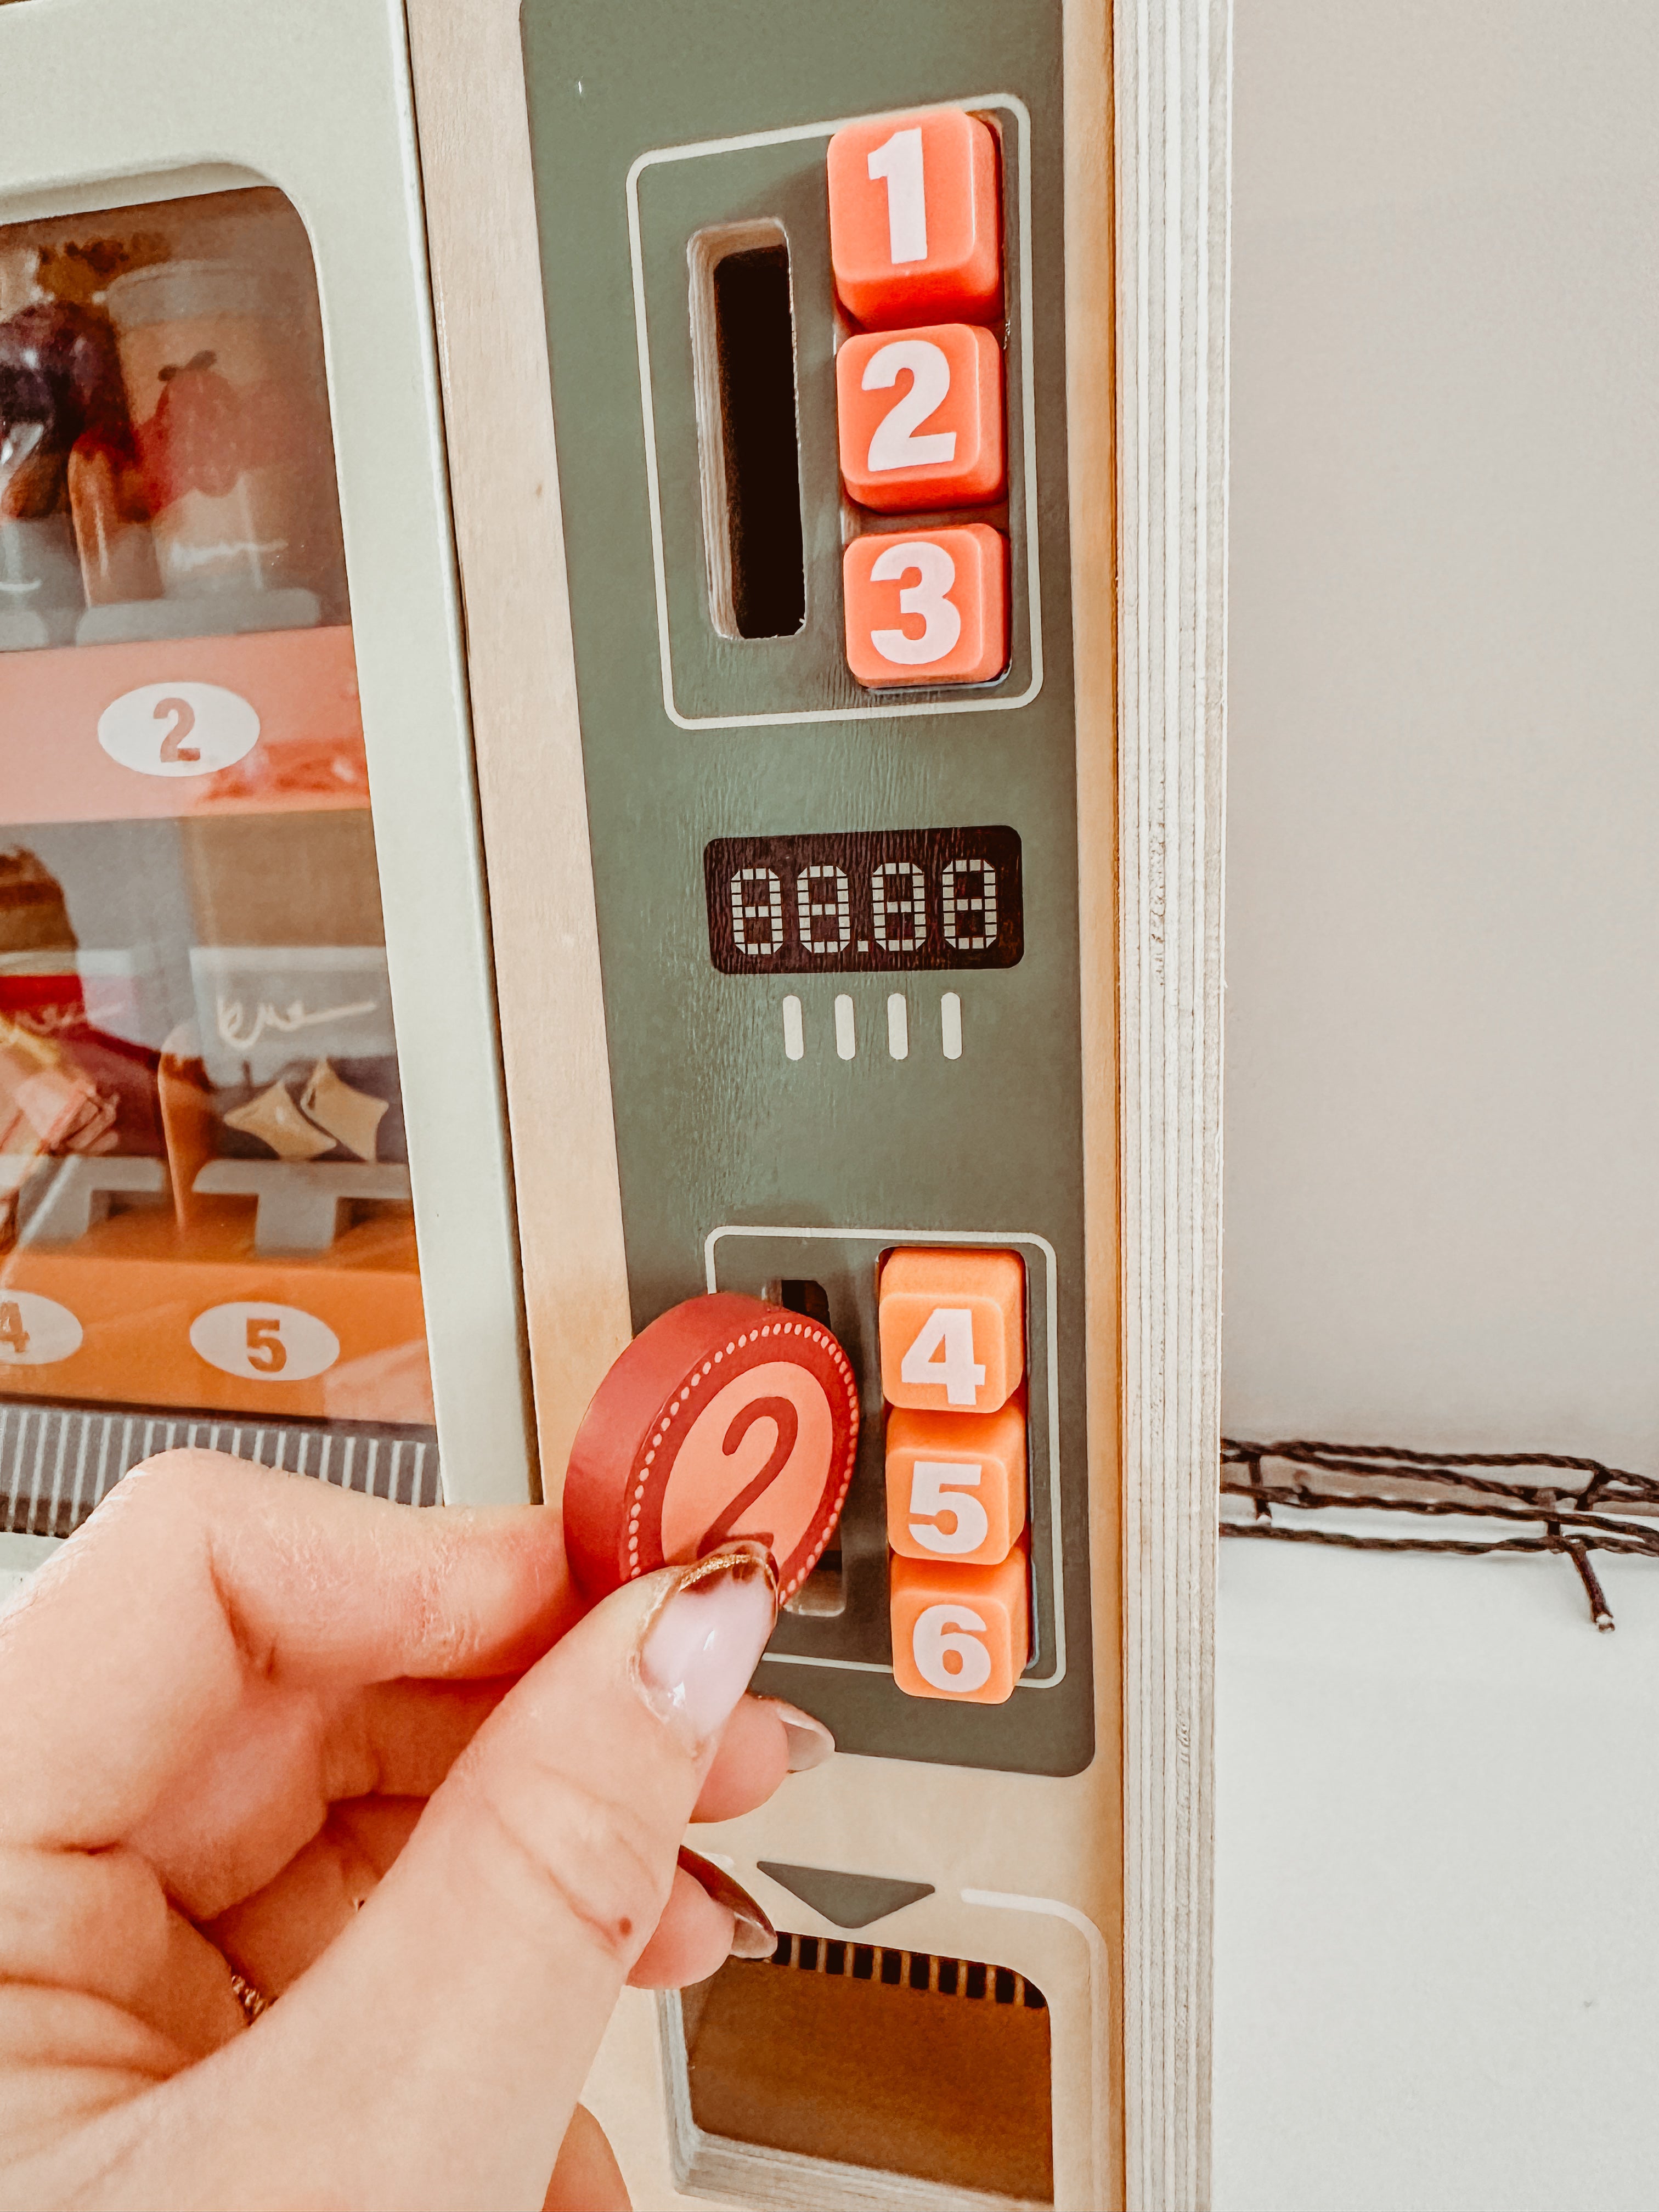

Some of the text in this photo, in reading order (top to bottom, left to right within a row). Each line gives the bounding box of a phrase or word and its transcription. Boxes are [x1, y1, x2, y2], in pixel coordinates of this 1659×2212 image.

[867, 127, 927, 264] 1
[861, 340, 957, 472] 2
[870, 541, 961, 665] 3
[153, 697, 201, 763] 2
[731, 859, 997, 955] 88.88
[0, 1301, 30, 1353] 4
[246, 1318, 287, 1373] 5
[901, 1308, 986, 1406] 4
[696, 1396, 798, 1559] 2
[909, 1461, 988, 1555] 5
[913, 1605, 991, 1693] 6
